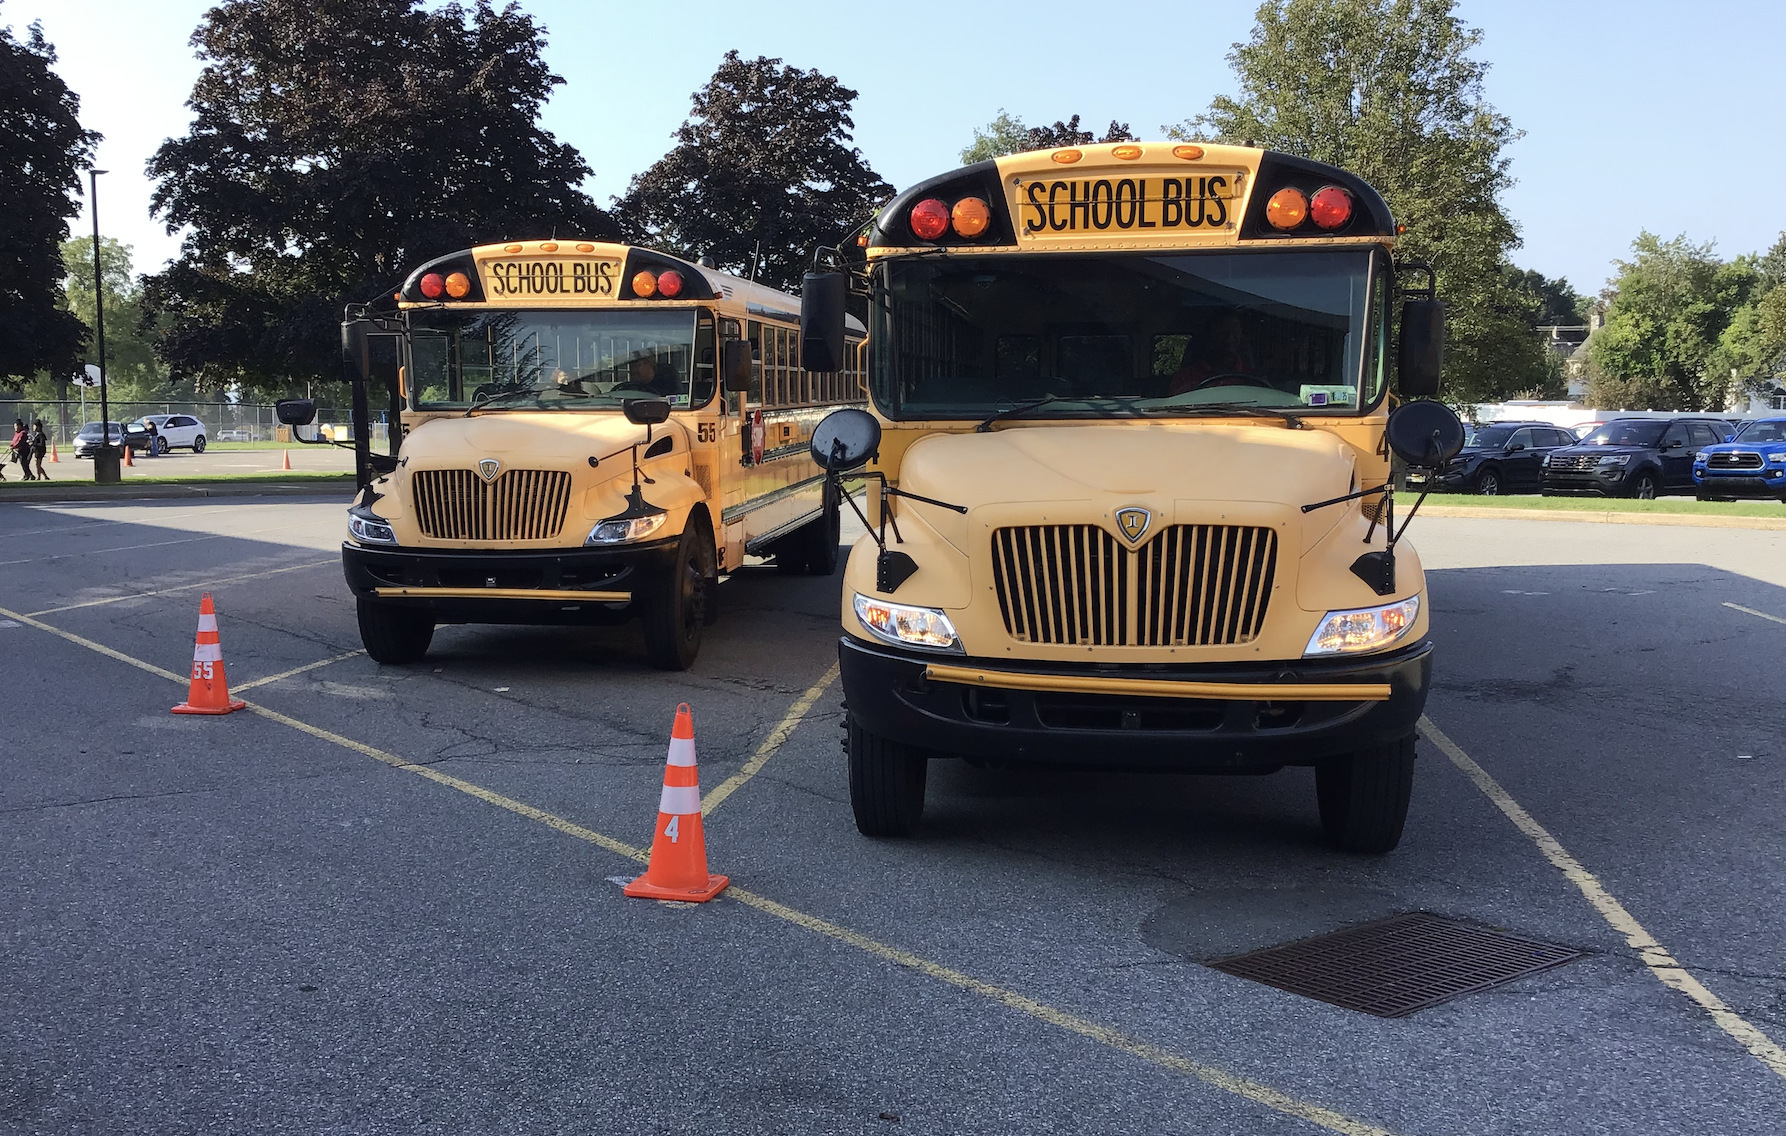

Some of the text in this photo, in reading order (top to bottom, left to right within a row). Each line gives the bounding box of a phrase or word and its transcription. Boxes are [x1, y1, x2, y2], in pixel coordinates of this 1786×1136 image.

[1027, 176, 1227, 232] SCHOOL BUS
[493, 262, 612, 294] SCHOOL BUS
[697, 422, 716, 443] 55
[1376, 430, 1389, 462] 4
[193, 661, 214, 680] 55
[664, 815, 679, 843] 4
